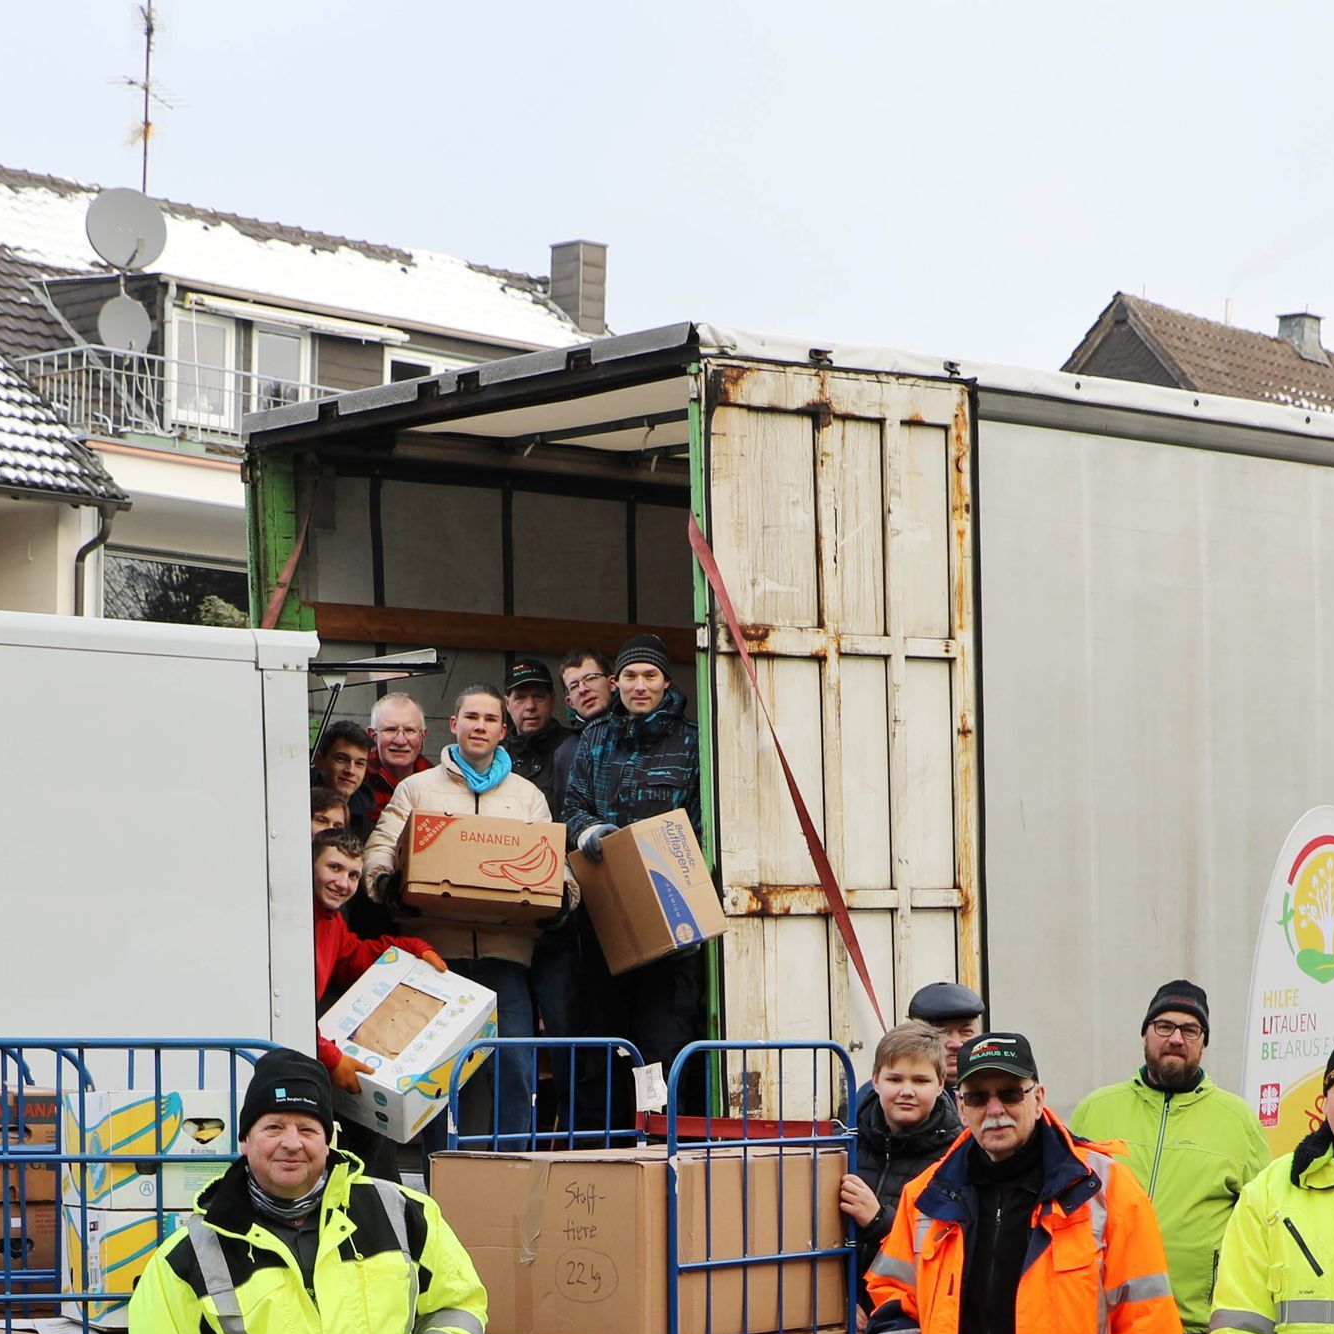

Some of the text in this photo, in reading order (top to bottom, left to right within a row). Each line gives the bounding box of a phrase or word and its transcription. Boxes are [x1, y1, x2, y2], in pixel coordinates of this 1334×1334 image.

[460, 830, 520, 847] BANANEN
[663, 819, 691, 877] Auflagen
[665, 882, 681, 918] PREMIUM
[1263, 988, 1300, 1009] HILFE
[1262, 1012, 1317, 1035] LITAUEN
[1261, 1037, 1320, 1060] BELARUS
[564, 1181, 606, 1216] Stoff-
[563, 1218, 597, 1241] tiere
[566, 1260, 602, 1294] 22 kg
